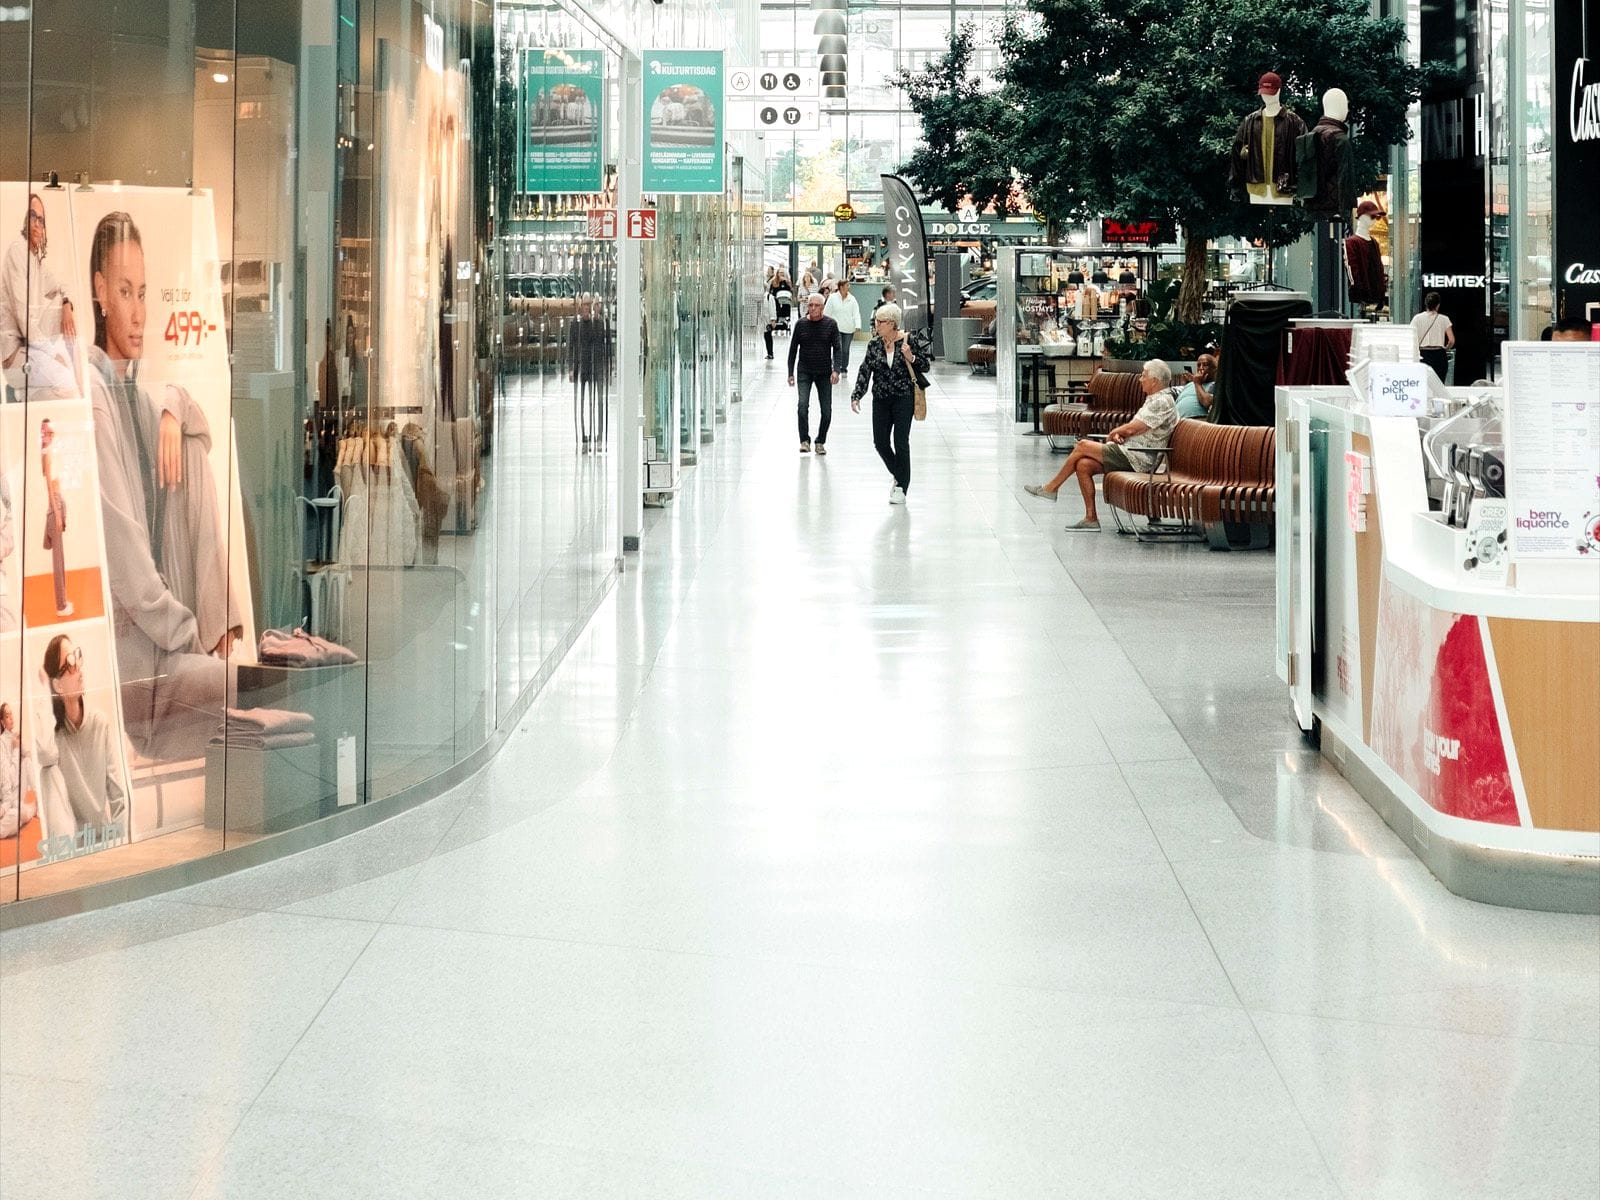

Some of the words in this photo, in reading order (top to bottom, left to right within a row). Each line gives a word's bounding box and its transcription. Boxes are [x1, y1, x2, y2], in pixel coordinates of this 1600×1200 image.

[661, 66, 716, 76] KULTURTISDAG
[963, 209, 974, 220] A
[931, 223, 991, 235] DOLCE
[1422, 274, 1485, 288] HEMTEX
[164, 311, 217, 346] 499:-
[1391, 378, 1420, 388] order
[1382, 385, 1405, 395] pick
[1395, 394, 1409, 402] up
[1480, 506, 1506, 518] OREO
[1529, 509, 1562, 521] berry
